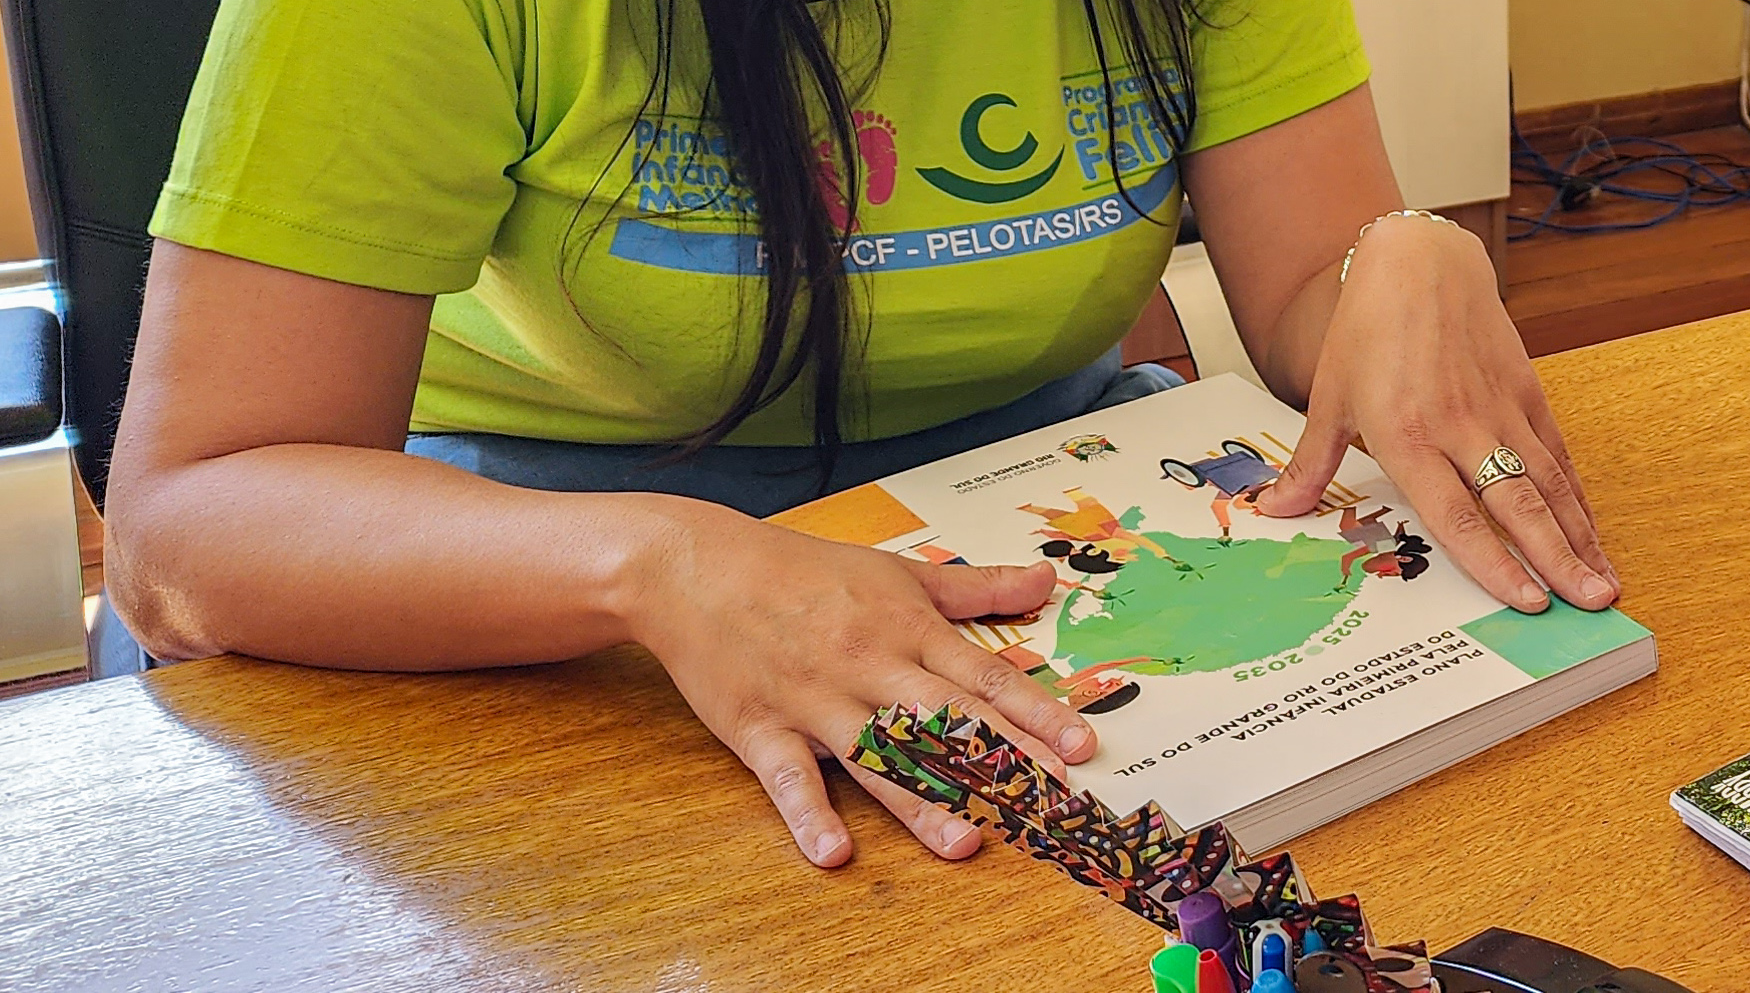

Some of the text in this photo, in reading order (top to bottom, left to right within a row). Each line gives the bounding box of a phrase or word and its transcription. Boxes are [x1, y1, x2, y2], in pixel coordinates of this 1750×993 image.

[1075, 120, 1185, 181] Feli
[926, 198, 1123, 260] PELOTAS/RS
[949, 453, 1056, 489] RIO GRANDE DO SUL
[957, 458, 1062, 495] GOVERNO DO ESTADO
[1233, 610, 1370, 683] 2025 2035
[1113, 630, 1456, 777] DO ESTADO DO RIO GRANDE DO SUL
[1230, 639, 1470, 741] PELA PRIMEIRA INFÂNCIA
[1321, 649, 1485, 716] PLANO ESTADUAL
